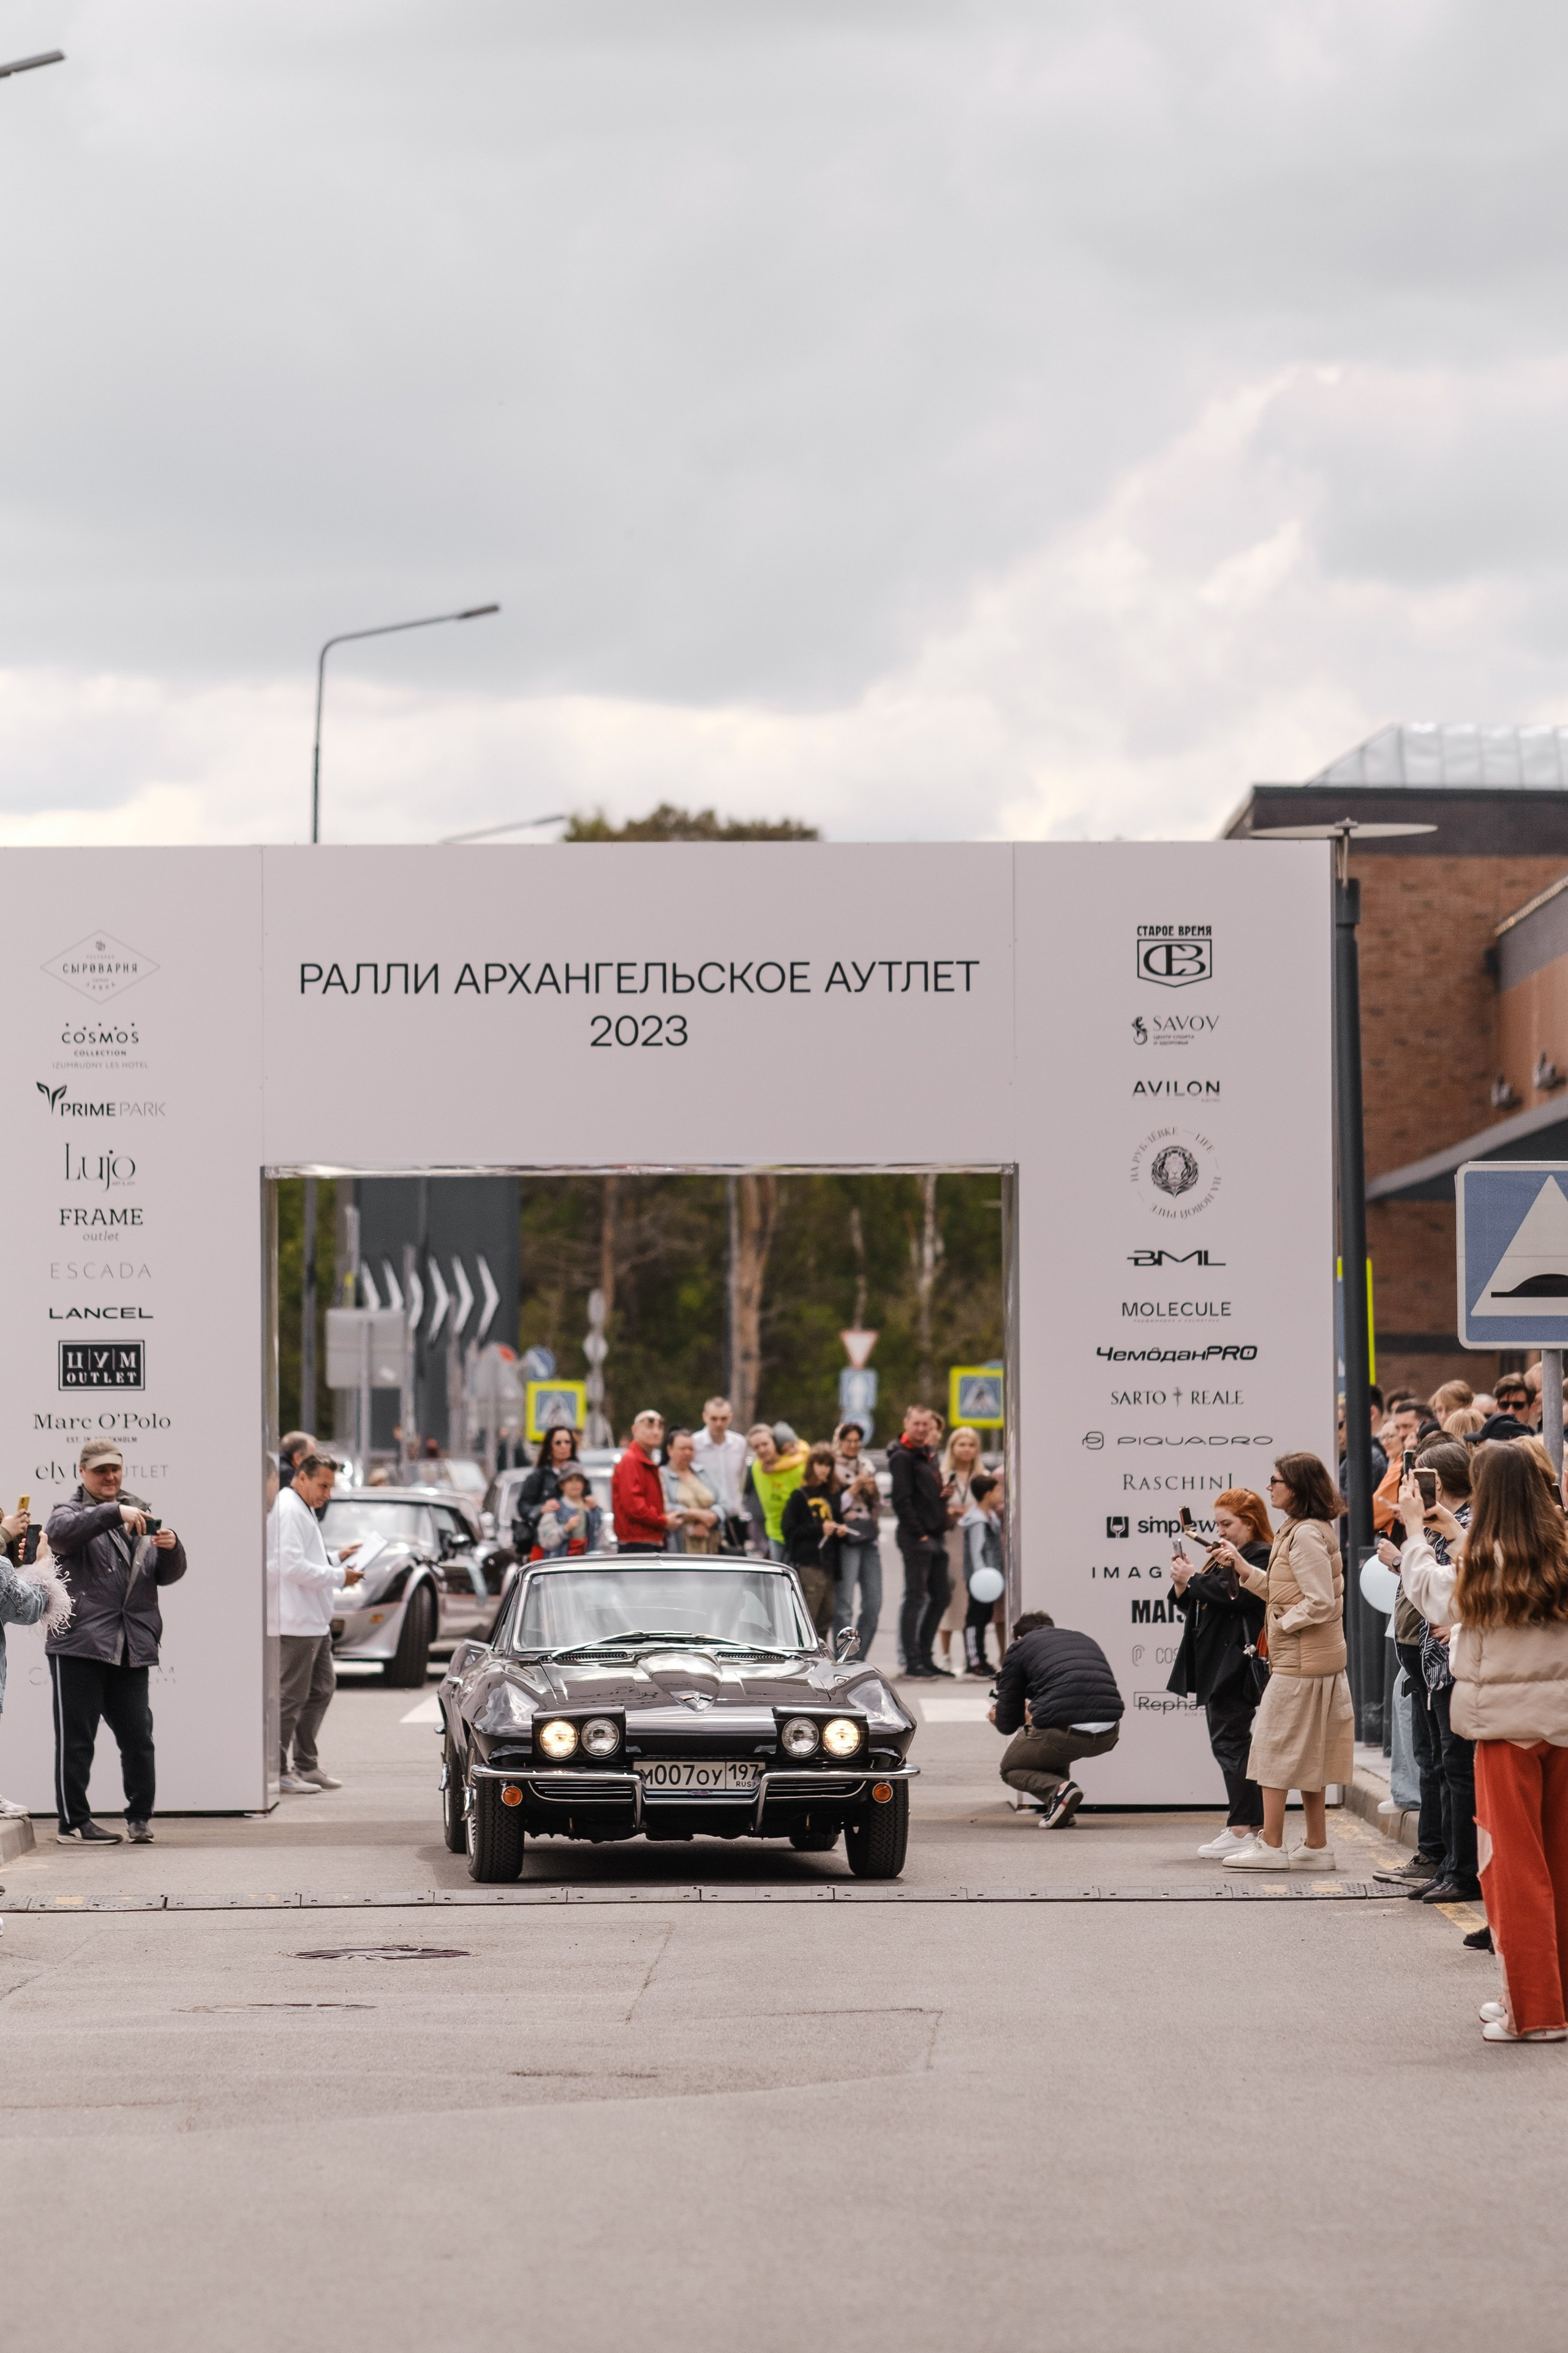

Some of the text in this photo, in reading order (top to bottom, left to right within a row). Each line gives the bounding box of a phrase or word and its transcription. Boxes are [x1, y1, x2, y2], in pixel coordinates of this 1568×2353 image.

[1137, 925, 1212, 937] СТАРОЕ ВРЕМЯ
[62, 963, 138, 974] СЫРОВАРНЯ
[301, 960, 980, 995] РАЛЛИ АРХАНГЕЛЬСКОЕ АУТЛЕТ
[590, 1014, 688, 1046] 2023
[1153, 1015, 1219, 1032] SAVOY
[61, 1032, 139, 1044] COSMOS
[105, 1061, 119, 1070] LES
[122, 1061, 149, 1070] HOTEL
[1132, 1081, 1220, 1097] AVILON
[61, 1102, 166, 1117] PRIME PARK
[65, 1143, 136, 1192] Lujo
[59, 1208, 143, 1226] FRAME
[83, 1230, 119, 1242] outlet
[1127, 1250, 1226, 1266] BML
[50, 1262, 152, 1280] ESCADA
[49, 1307, 154, 1319] LANCEL
[1122, 1302, 1232, 1316] MOLECULE
[67, 1351, 137, 1369] ЦУМ
[67, 1372, 137, 1384] OUTLET
[1110, 1390, 1244, 1405] SARTO REALE
[33, 1413, 92, 1430] Marc
[1117, 1436, 1273, 1446] PIQUADRO
[1123, 1473, 1232, 1490] RASCHINI
[1091, 1566, 1163, 1579] IMAG
[728, 1764, 759, 1780] 197
